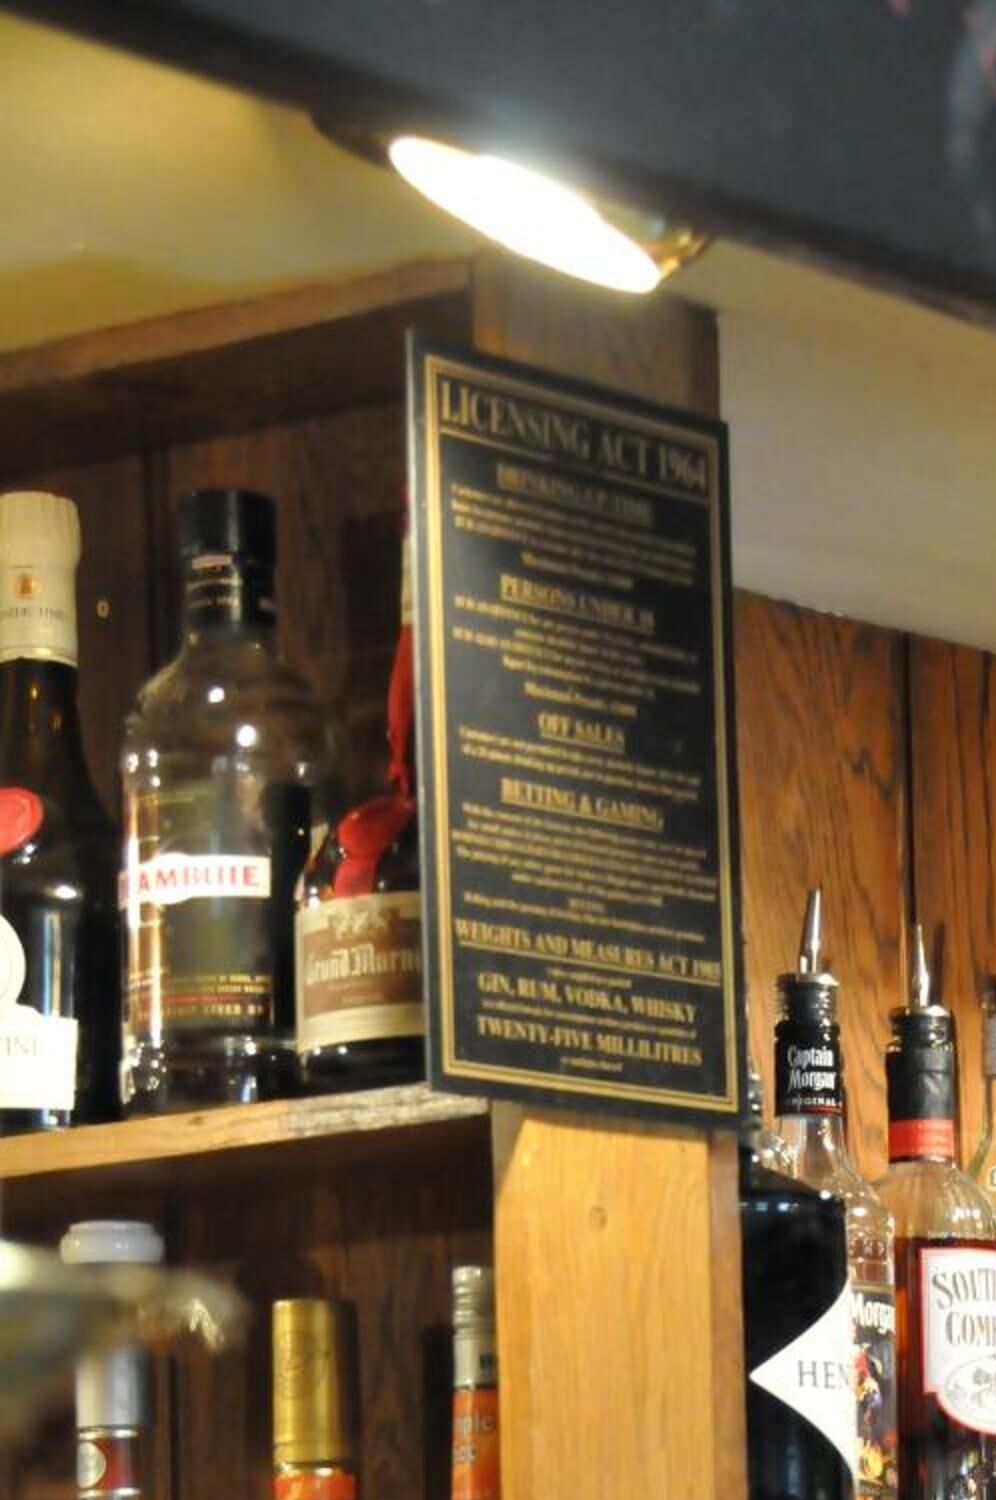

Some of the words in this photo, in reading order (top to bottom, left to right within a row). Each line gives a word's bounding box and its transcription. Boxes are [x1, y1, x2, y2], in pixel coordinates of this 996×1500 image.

[442, 380, 591, 460] LICENSING
[602, 427, 648, 475] ACT
[501, 776, 577, 812] BETTING
[578, 793, 593, 817] &
[594, 797, 664, 832] GAMING
[454, 917, 532, 948] WEIGHTS
[534, 933, 569, 955] AND
[571, 937, 655, 967] MEASURES
[658, 952, 690, 976] ACT
[631, 995, 696, 1025] WHISKY
[477, 1014, 593, 1052] TWENTY-FIVE
[596, 1032, 704, 1067] MILLILITRES
[787, 1045, 834, 1070] Captain
[787, 1069, 836, 1093] Morgan
